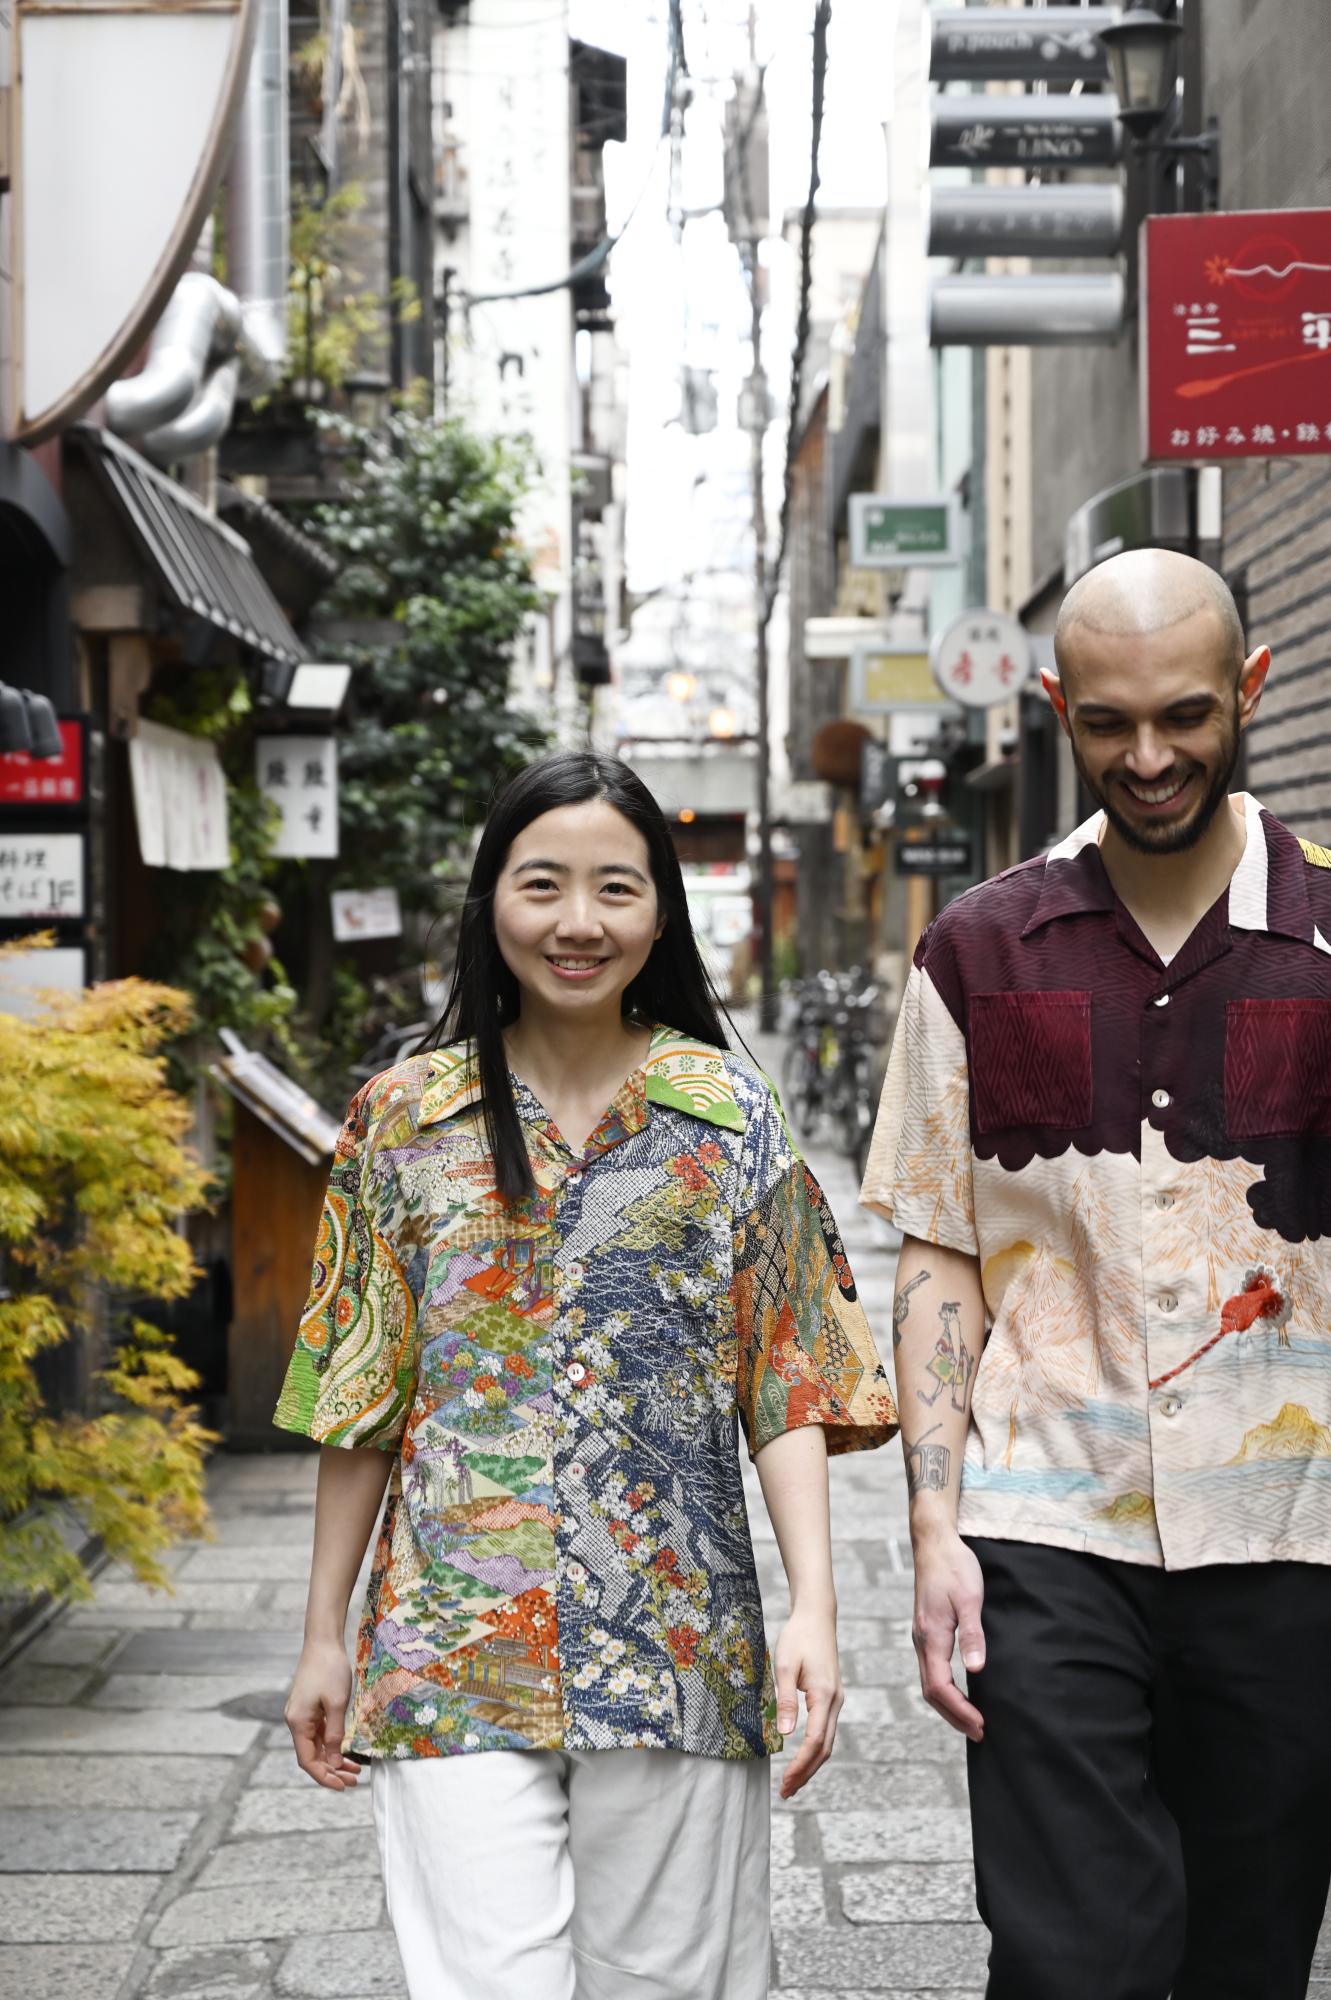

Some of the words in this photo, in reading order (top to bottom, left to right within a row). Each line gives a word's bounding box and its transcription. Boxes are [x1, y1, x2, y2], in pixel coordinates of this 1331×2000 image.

[1170, 422, 1331, 447] お好み焼・鉄
